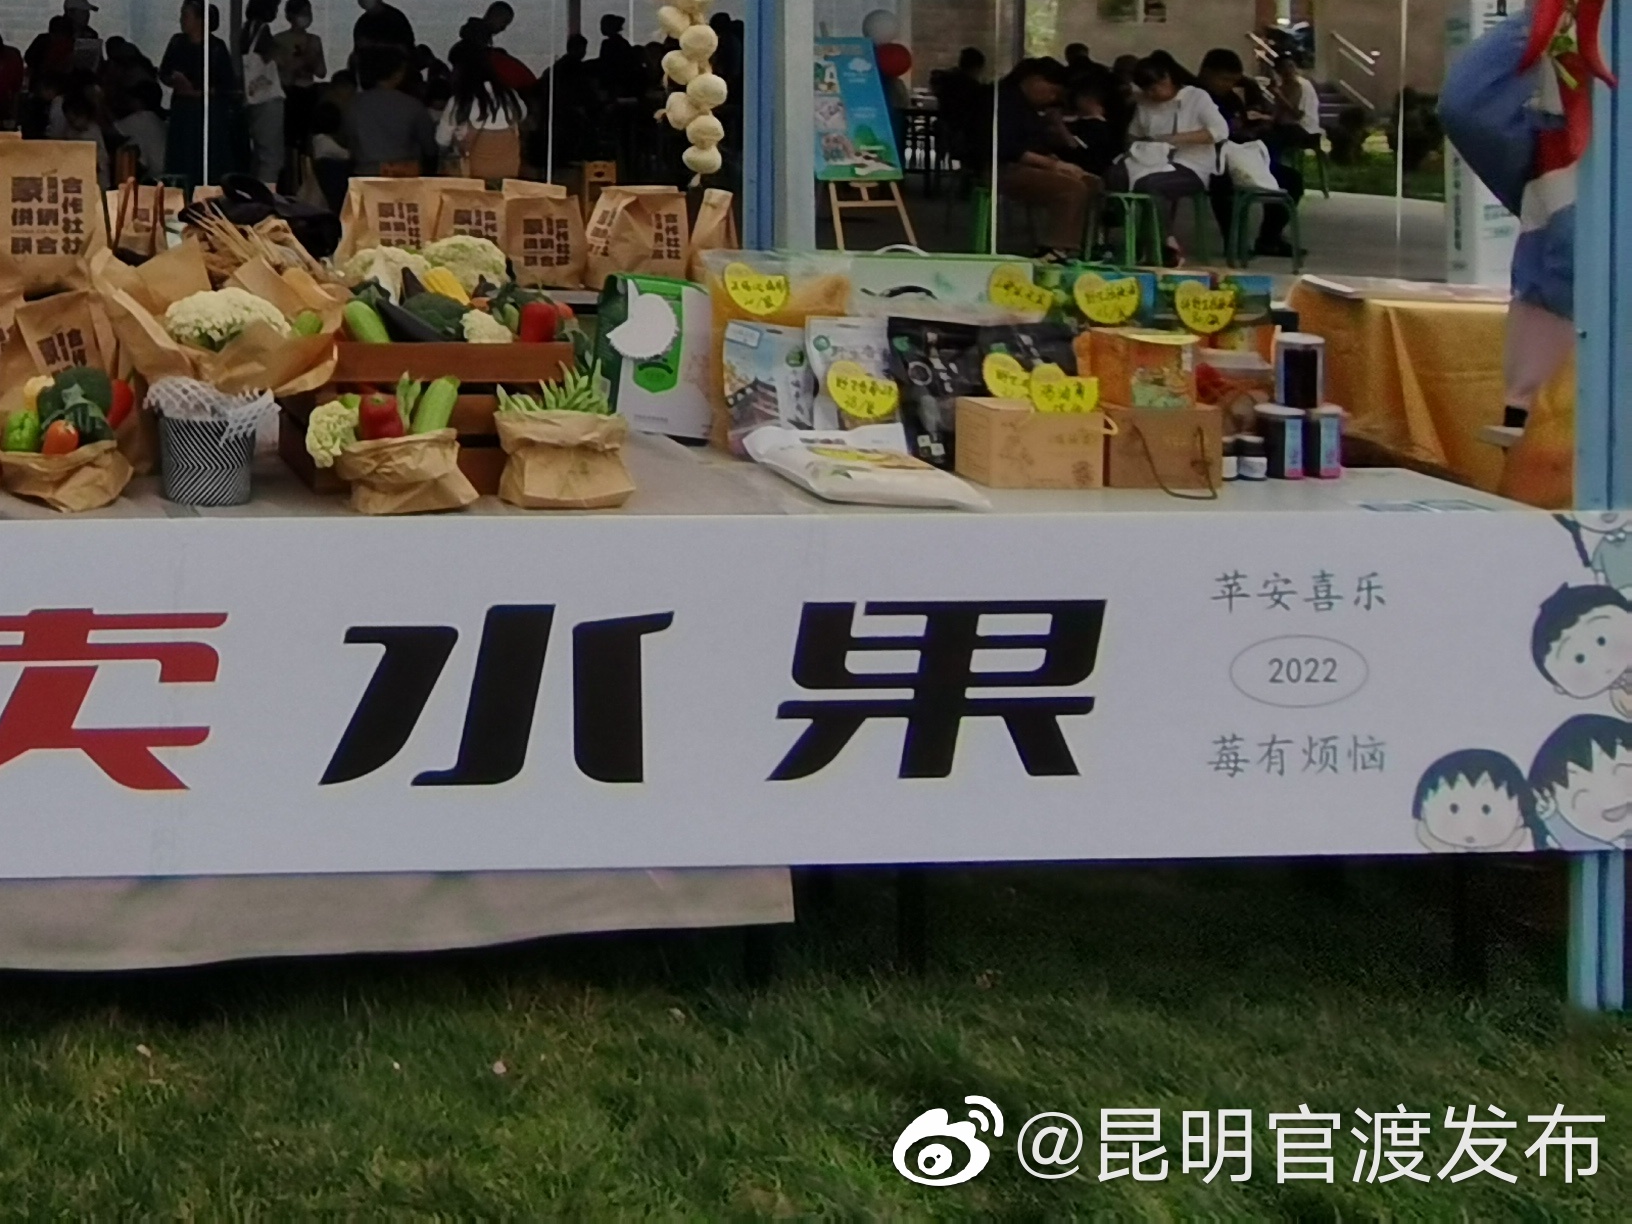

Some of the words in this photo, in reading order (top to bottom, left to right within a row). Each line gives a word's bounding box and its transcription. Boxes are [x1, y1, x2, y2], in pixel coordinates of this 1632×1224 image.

[1211, 569, 1386, 613] 苹安喜乐
[1268, 657, 1337, 684] 2022
[1208, 733, 1385, 777] 莓有烦恼
